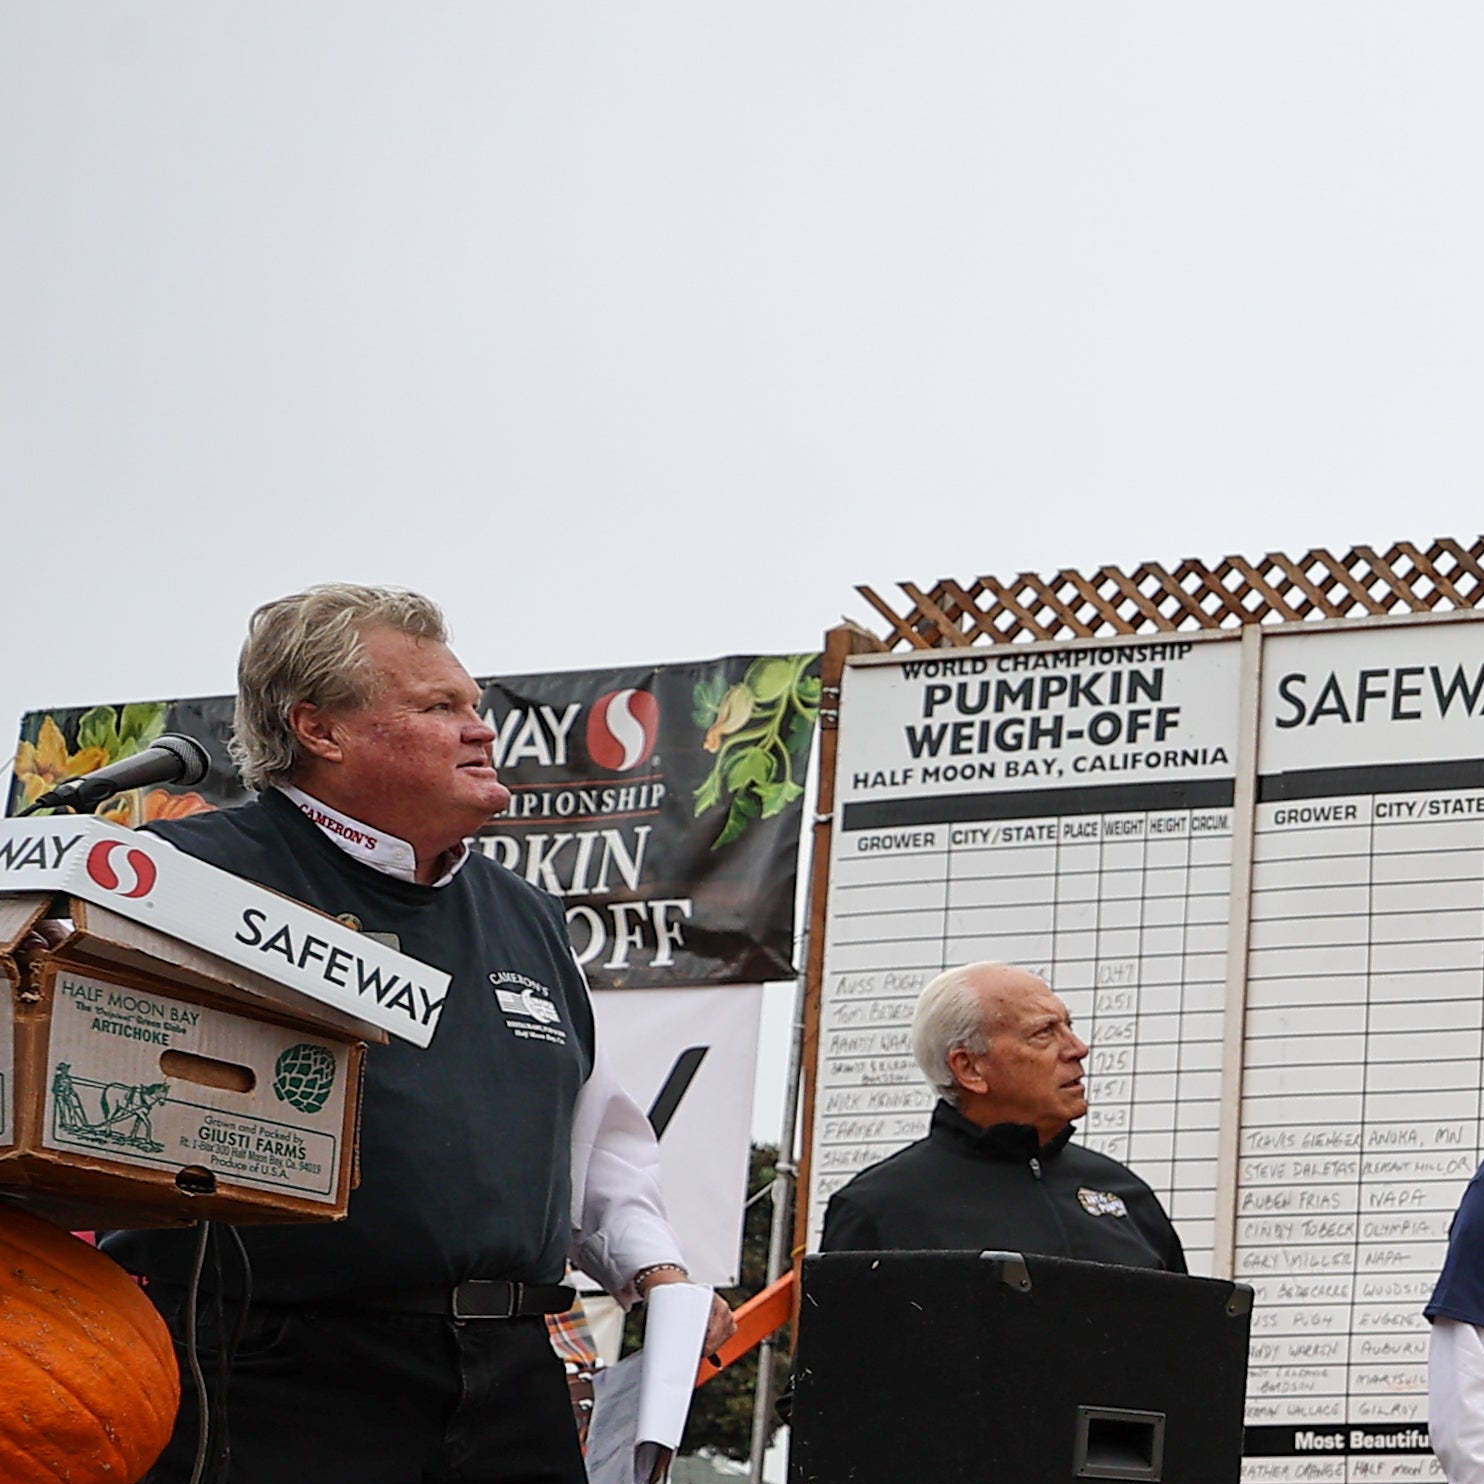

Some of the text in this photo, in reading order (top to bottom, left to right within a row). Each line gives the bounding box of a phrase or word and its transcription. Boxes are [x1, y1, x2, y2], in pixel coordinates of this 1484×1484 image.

[901, 642, 1193, 681] WORLD CHAMPIONSHIP
[922, 667, 1165, 718] PUMPKIN
[904, 706, 1181, 760] WEIGH-OFF
[852, 747, 1230, 790] HALF MOON BAY, CALIFORNIA
[299, 803, 378, 850] CAMERON'S
[857, 814, 1230, 852] GROWER CITY/STATE PLACE WEIGHT HEIGHT CIRCUM.
[1273, 805, 1358, 826] GROWER
[235, 908, 445, 1027] SAFEWAY
[62, 980, 200, 1027] HALF MOON BAY
[92, 1018, 170, 1046] ARTICHOKE
[198, 1126, 307, 1161] GIUSTI FARMS
[203, 1115, 304, 1146] Grown and Packed by
[210, 1154, 248, 1171] Produce
[250, 1162, 259, 1173] of
[1295, 1431, 1346, 1451] Most
